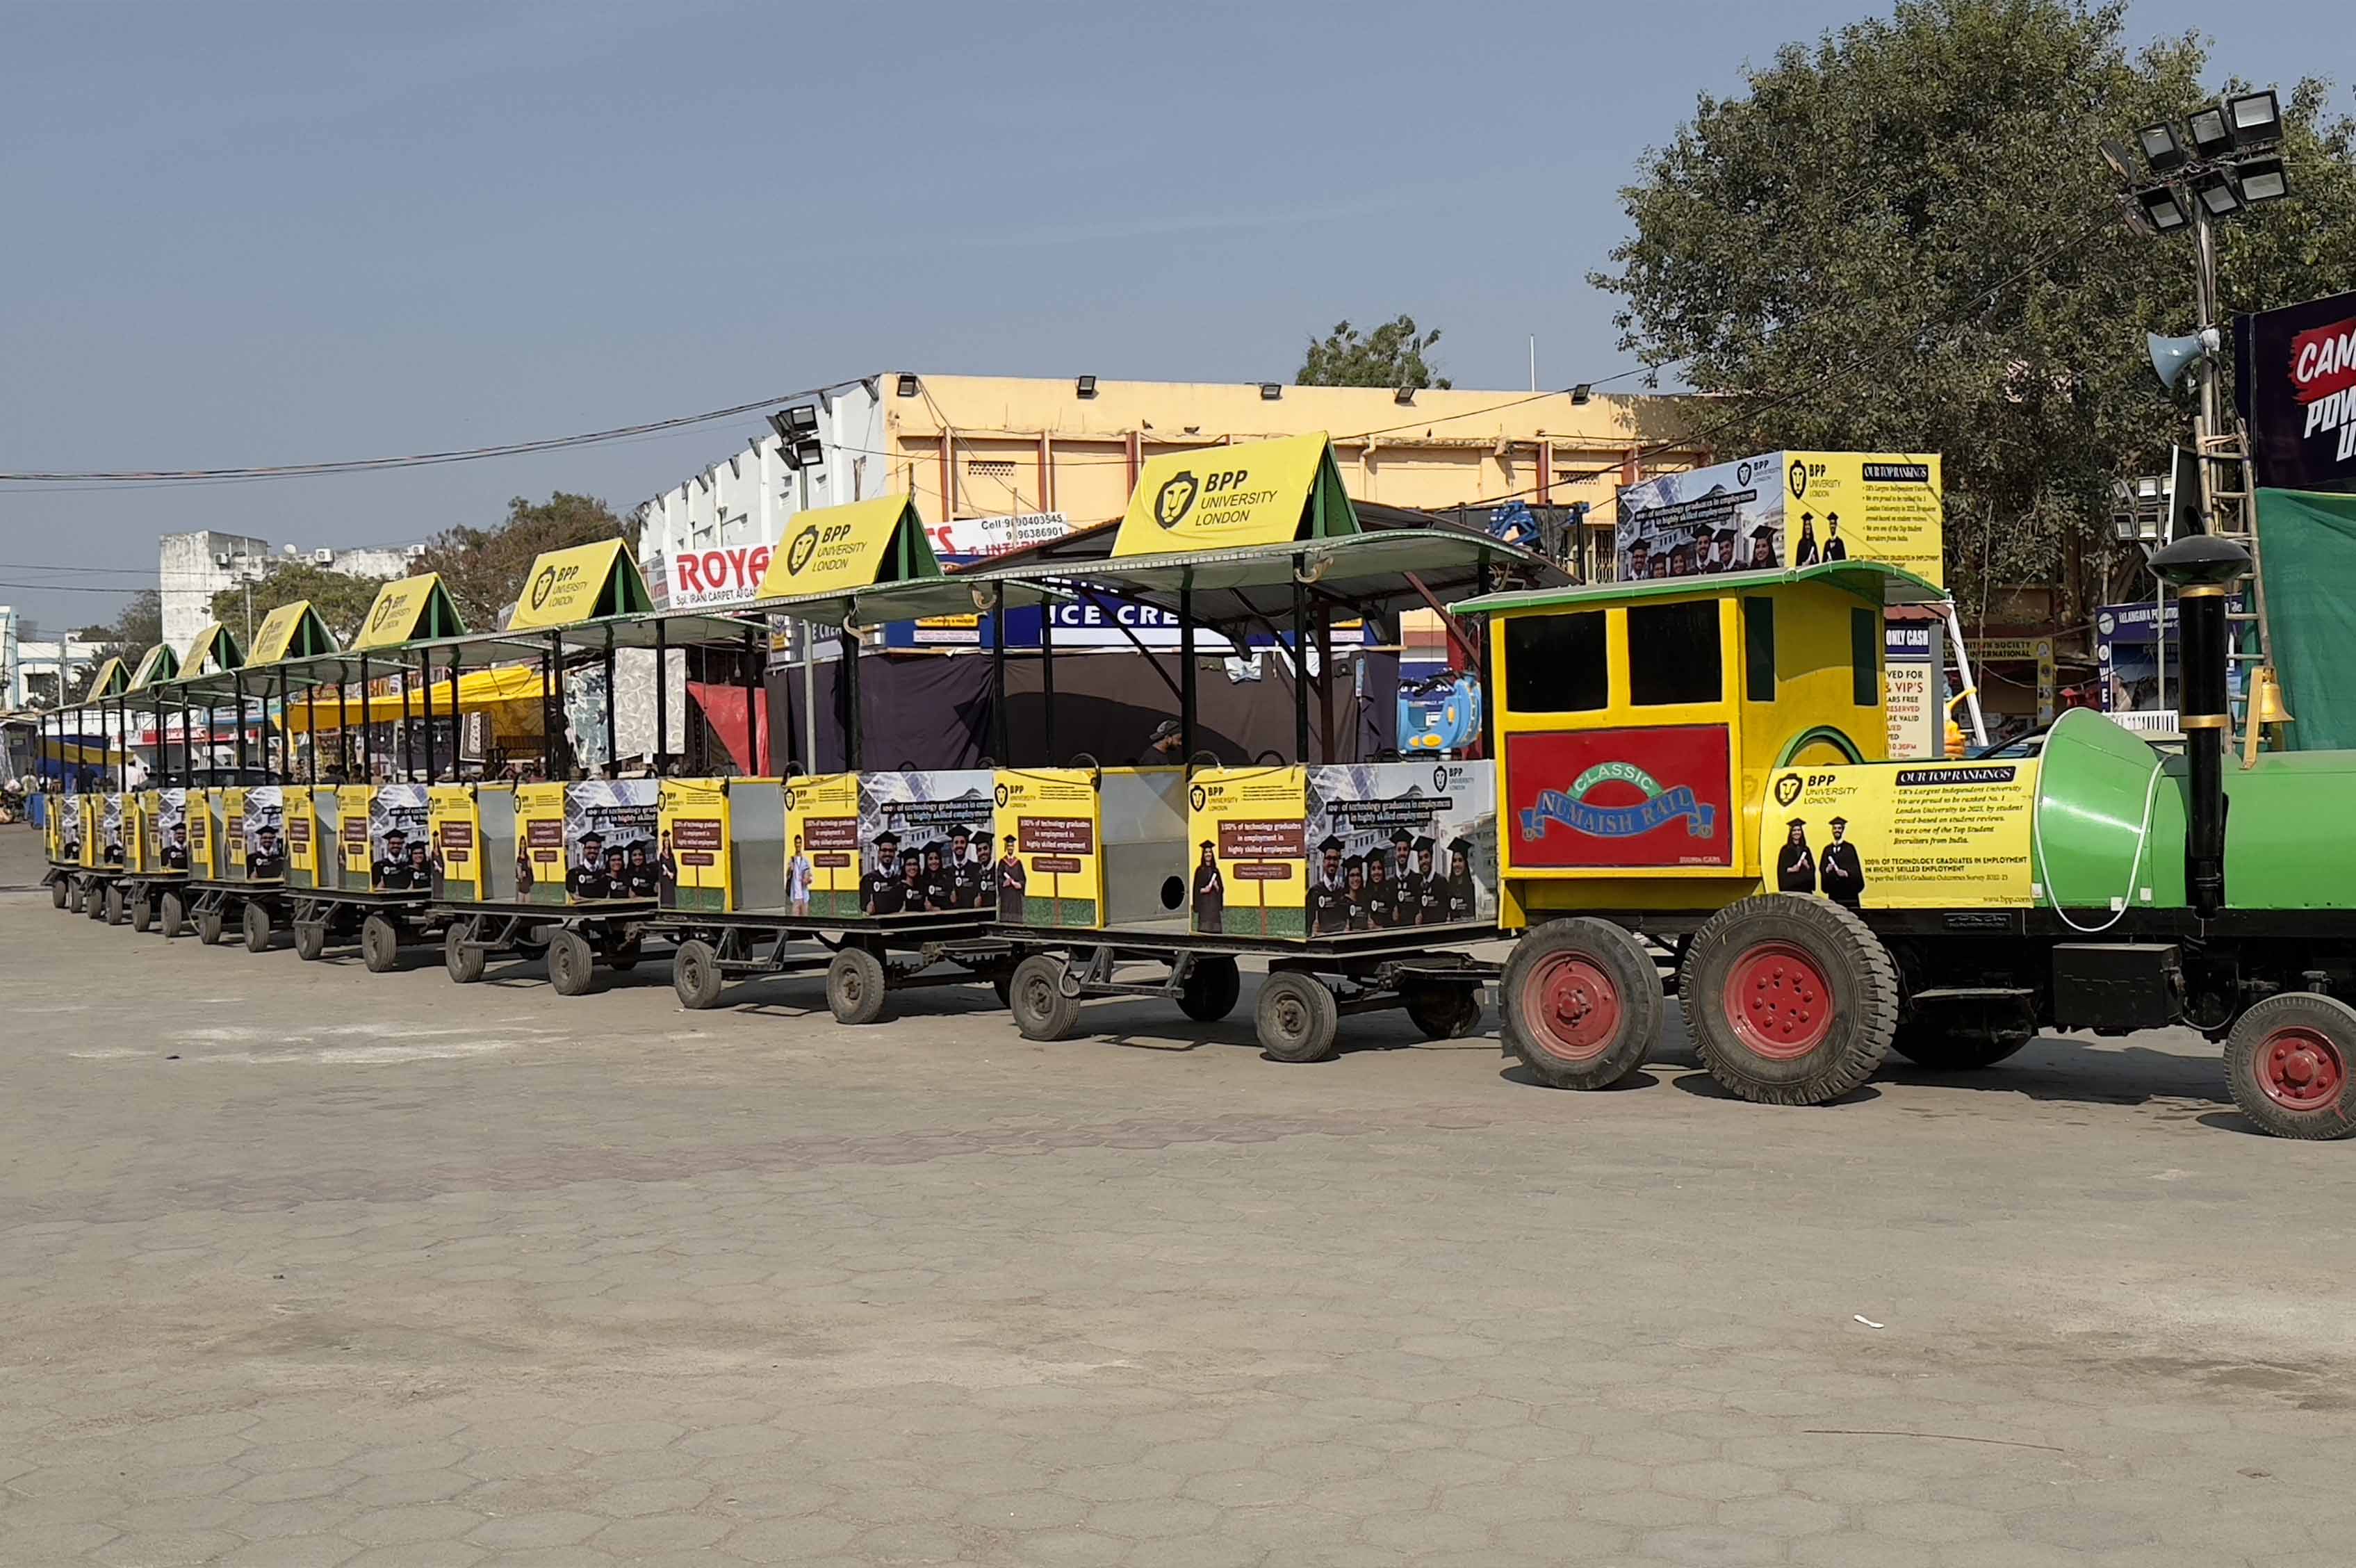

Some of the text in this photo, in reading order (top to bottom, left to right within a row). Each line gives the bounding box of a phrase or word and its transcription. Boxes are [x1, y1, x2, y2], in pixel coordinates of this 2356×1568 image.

[2336, 421, 2356, 462] U
[1753, 459, 1769, 471] BPP
[1809, 464, 1826, 477] BPP
[1204, 470, 1248, 493] BPP
[1809, 480, 1841, 488] UNIVERSITY
[1200, 490, 1278, 509] UNIVERSITY
[1195, 509, 1250, 526] LONDON
[821, 523, 851, 544] BPP
[1006, 526, 1063, 541] 996386901
[817, 541, 867, 557] UNIVERSITY
[676, 544, 778, 594] ROYA
[812, 558, 849, 572] LONDON
[557, 566, 579, 582] BPP
[552, 581, 589, 596] UNIVERSITY
[548, 596, 574, 607] LONDON
[1049, 604, 1102, 626] ICE
[1885, 629, 1930, 646] ONLY CASH
[1995, 640, 2031, 650] SOCIETY
[1906, 670, 1924, 679] FOR
[1895, 682, 1924, 694] VIP'S
[1448, 767, 1463, 777] BPP
[1573, 764, 1653, 792] CLASSIC
[1900, 767, 2011, 783] OUR TOP RANKINGS
[1808, 774, 1835, 787] BPP
[1009, 785, 1024, 794] BPP
[1208, 786, 1224, 797] BPP
[1806, 787, 1858, 797] UNIVERSITY
[1942, 786, 1984, 794] Independent
[1986, 785, 2022, 794] University
[1803, 797, 1837, 805] LONDON
[1921, 797, 1942, 806] proud
[1541, 790, 1691, 833] NUMAISH RAIL
[1922, 806, 1958, 815] University
[1953, 826, 1965, 835] Top
[1983, 856, 2028, 864] EMPLOYMENT
[1922, 865, 1965, 873] EMPLOYMENT
